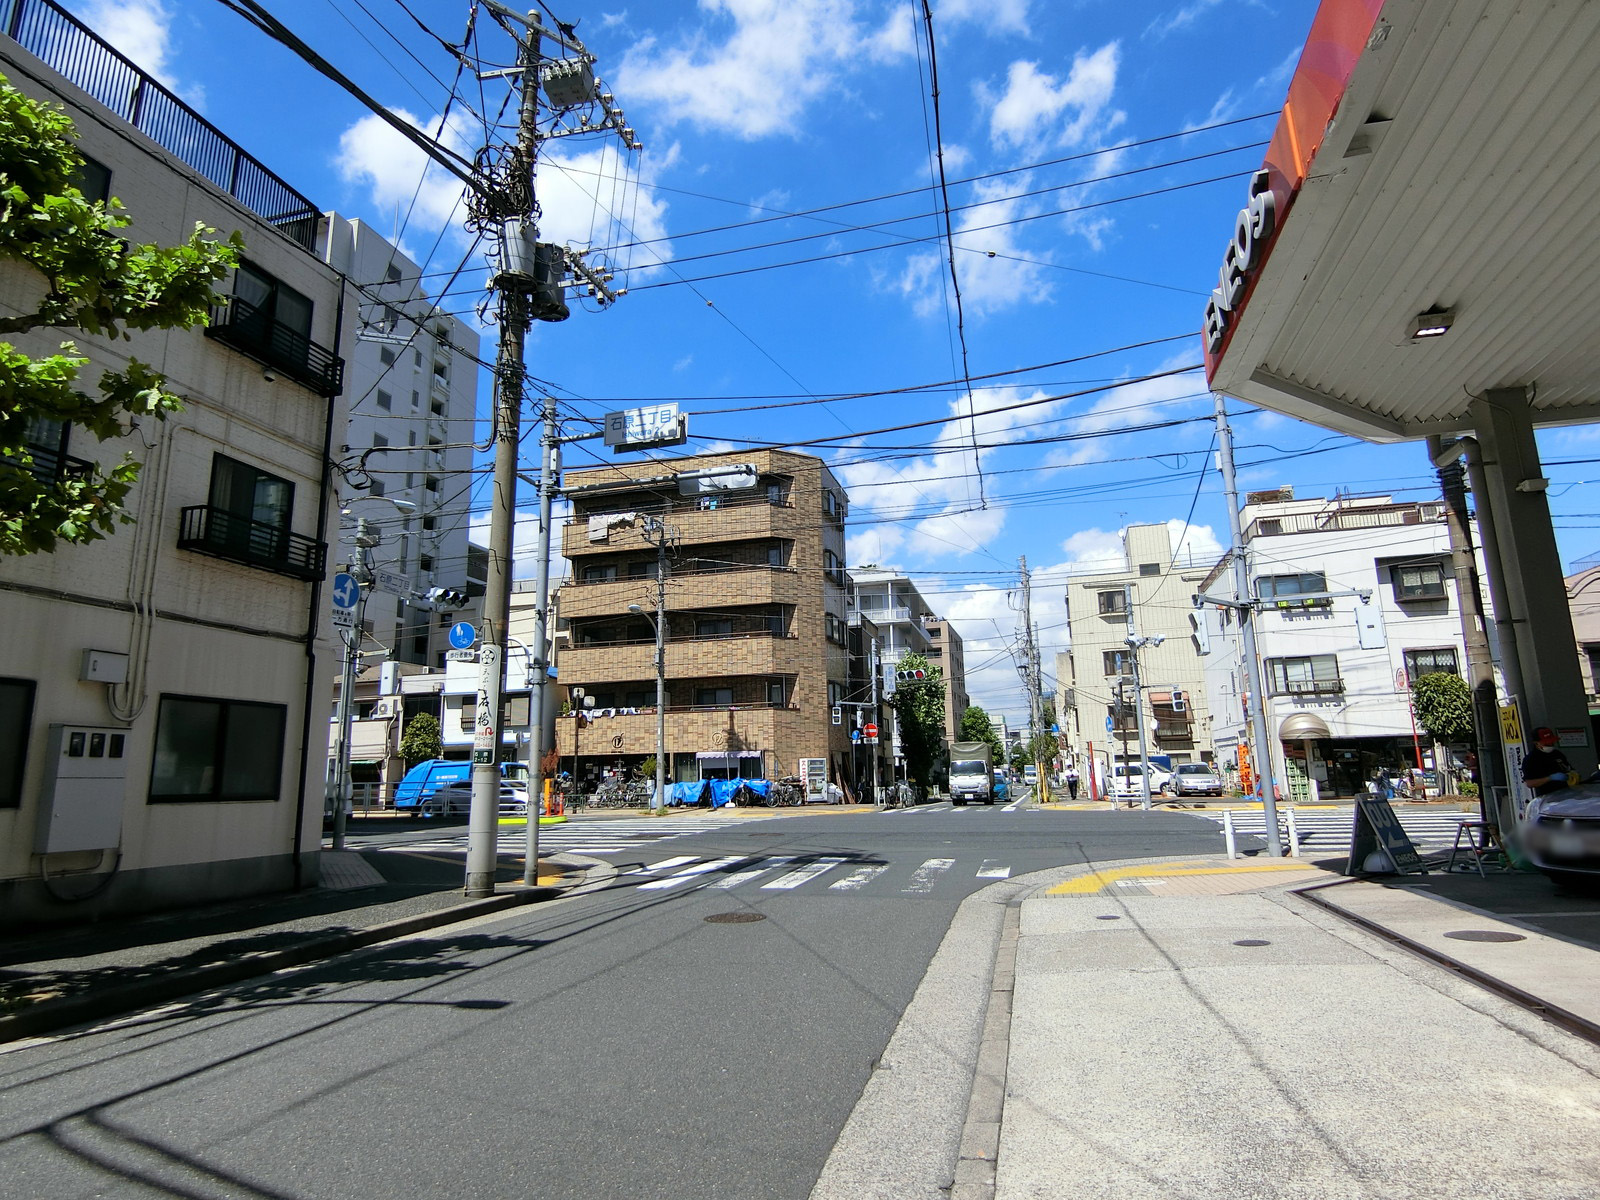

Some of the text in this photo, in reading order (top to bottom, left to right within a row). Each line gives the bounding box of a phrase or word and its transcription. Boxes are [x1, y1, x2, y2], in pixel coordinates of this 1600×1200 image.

[1204, 168, 1275, 354] ENEOS
[611, 410, 671, 430] 石原二丁目
[380, 573, 410, 590] 石原二丁目
[1366, 802, 1398, 828] OUT
